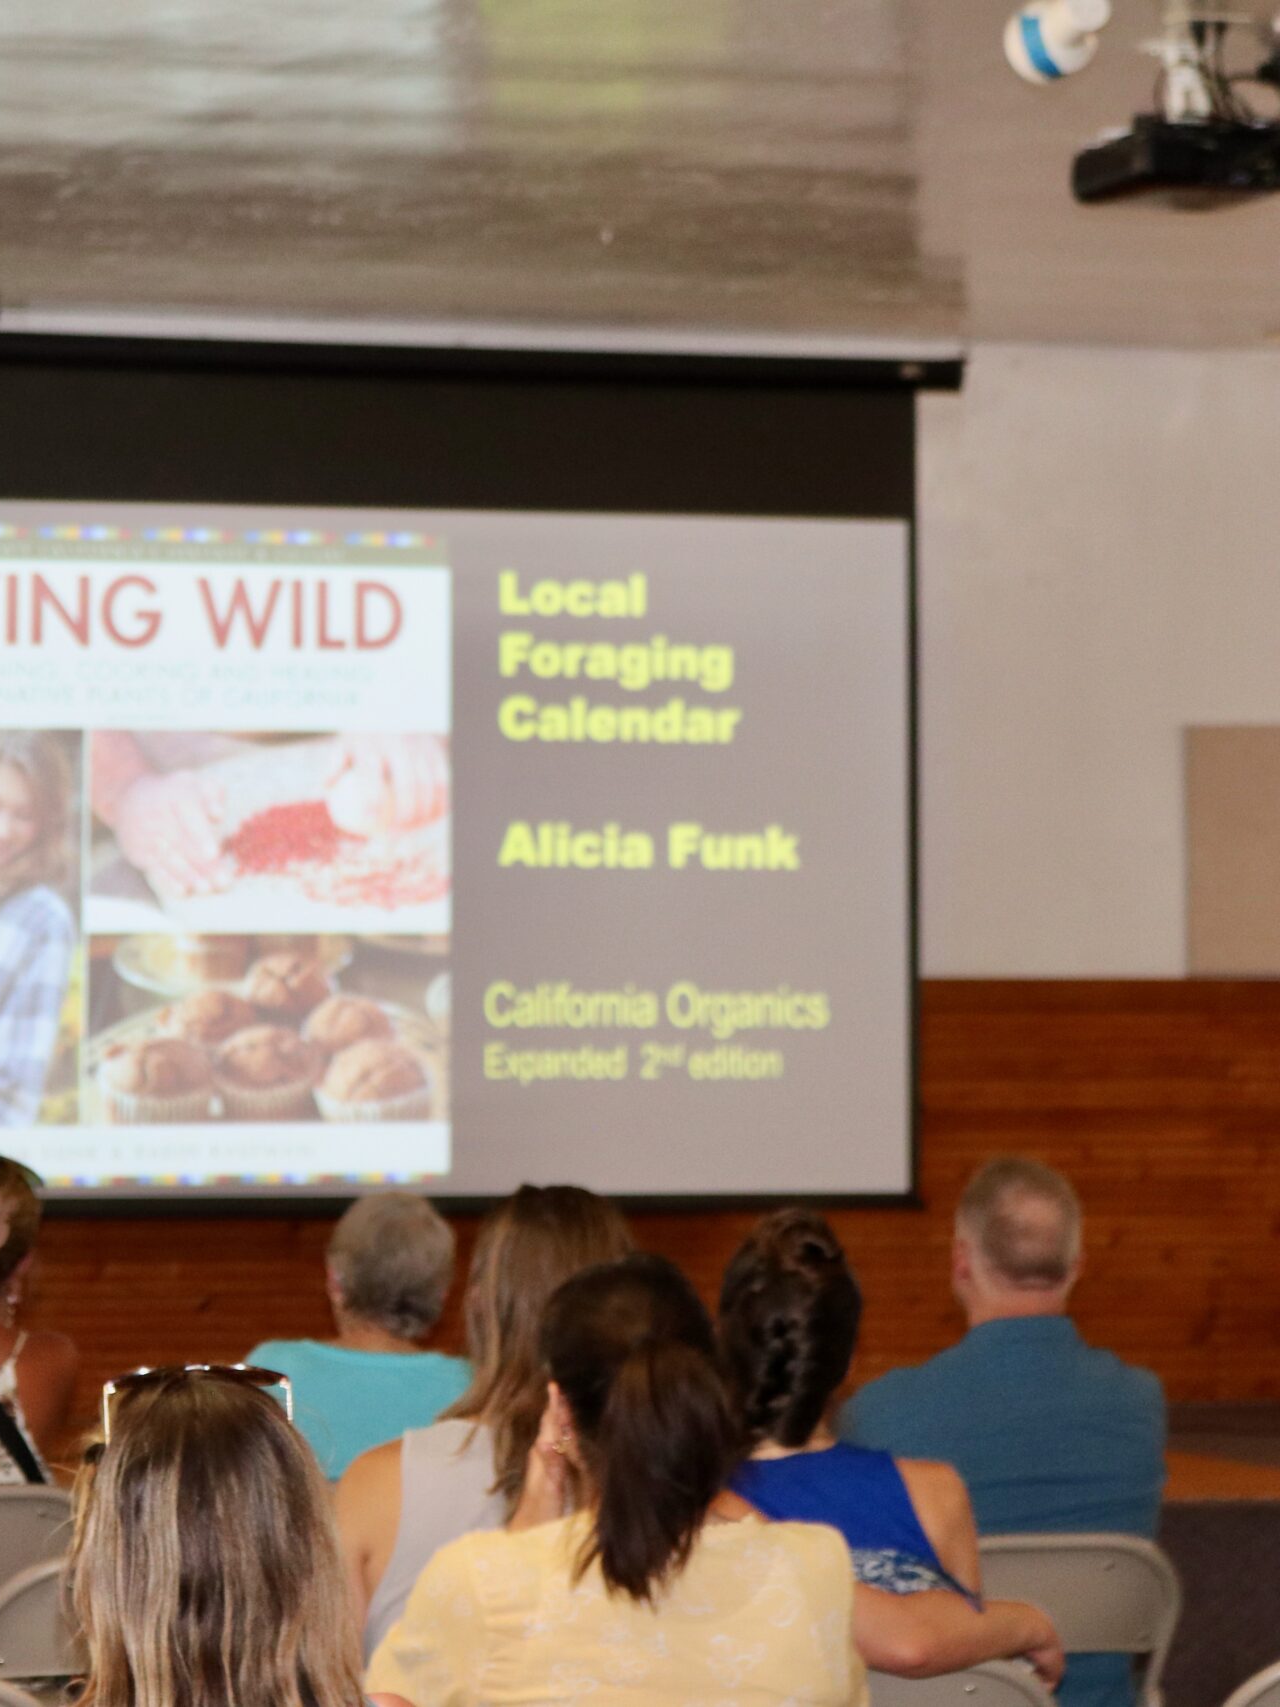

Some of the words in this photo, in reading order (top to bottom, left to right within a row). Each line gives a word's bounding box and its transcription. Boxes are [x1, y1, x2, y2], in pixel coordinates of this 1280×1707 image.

[198, 577, 404, 651] WILD
[499, 570, 647, 618] Local
[499, 632, 734, 692] Foraging
[498, 694, 742, 744] Calendar
[498, 821, 654, 868] Alicia
[668, 824, 800, 870] Funk
[483, 979, 658, 1030] California
[666, 980, 831, 1039] Organics
[483, 1041, 628, 1084] Expanded
[688, 1045, 784, 1080] edition
